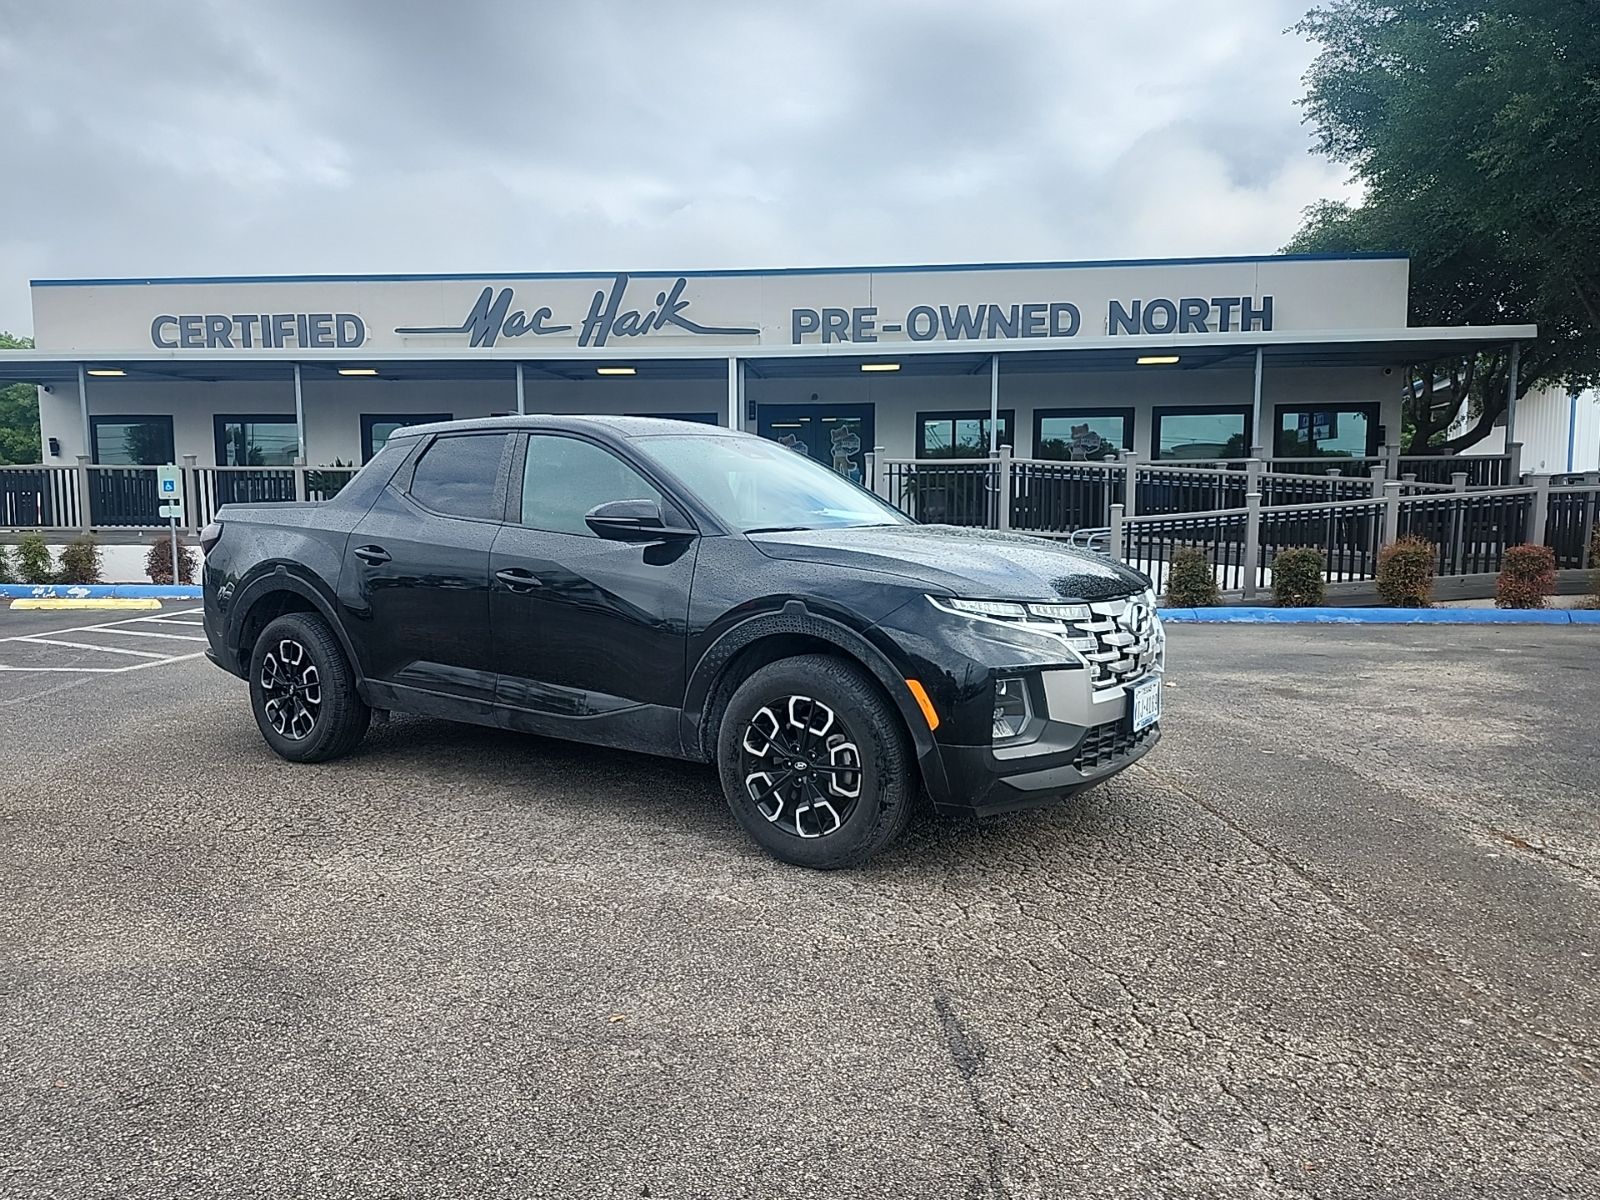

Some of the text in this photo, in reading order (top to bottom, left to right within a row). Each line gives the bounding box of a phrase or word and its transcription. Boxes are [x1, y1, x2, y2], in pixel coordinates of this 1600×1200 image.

[150, 313, 366, 349] CERTIFIED
[394, 272, 761, 348] Mac Haik
[792, 296, 1274, 345] PRE-OWNED NORTH
